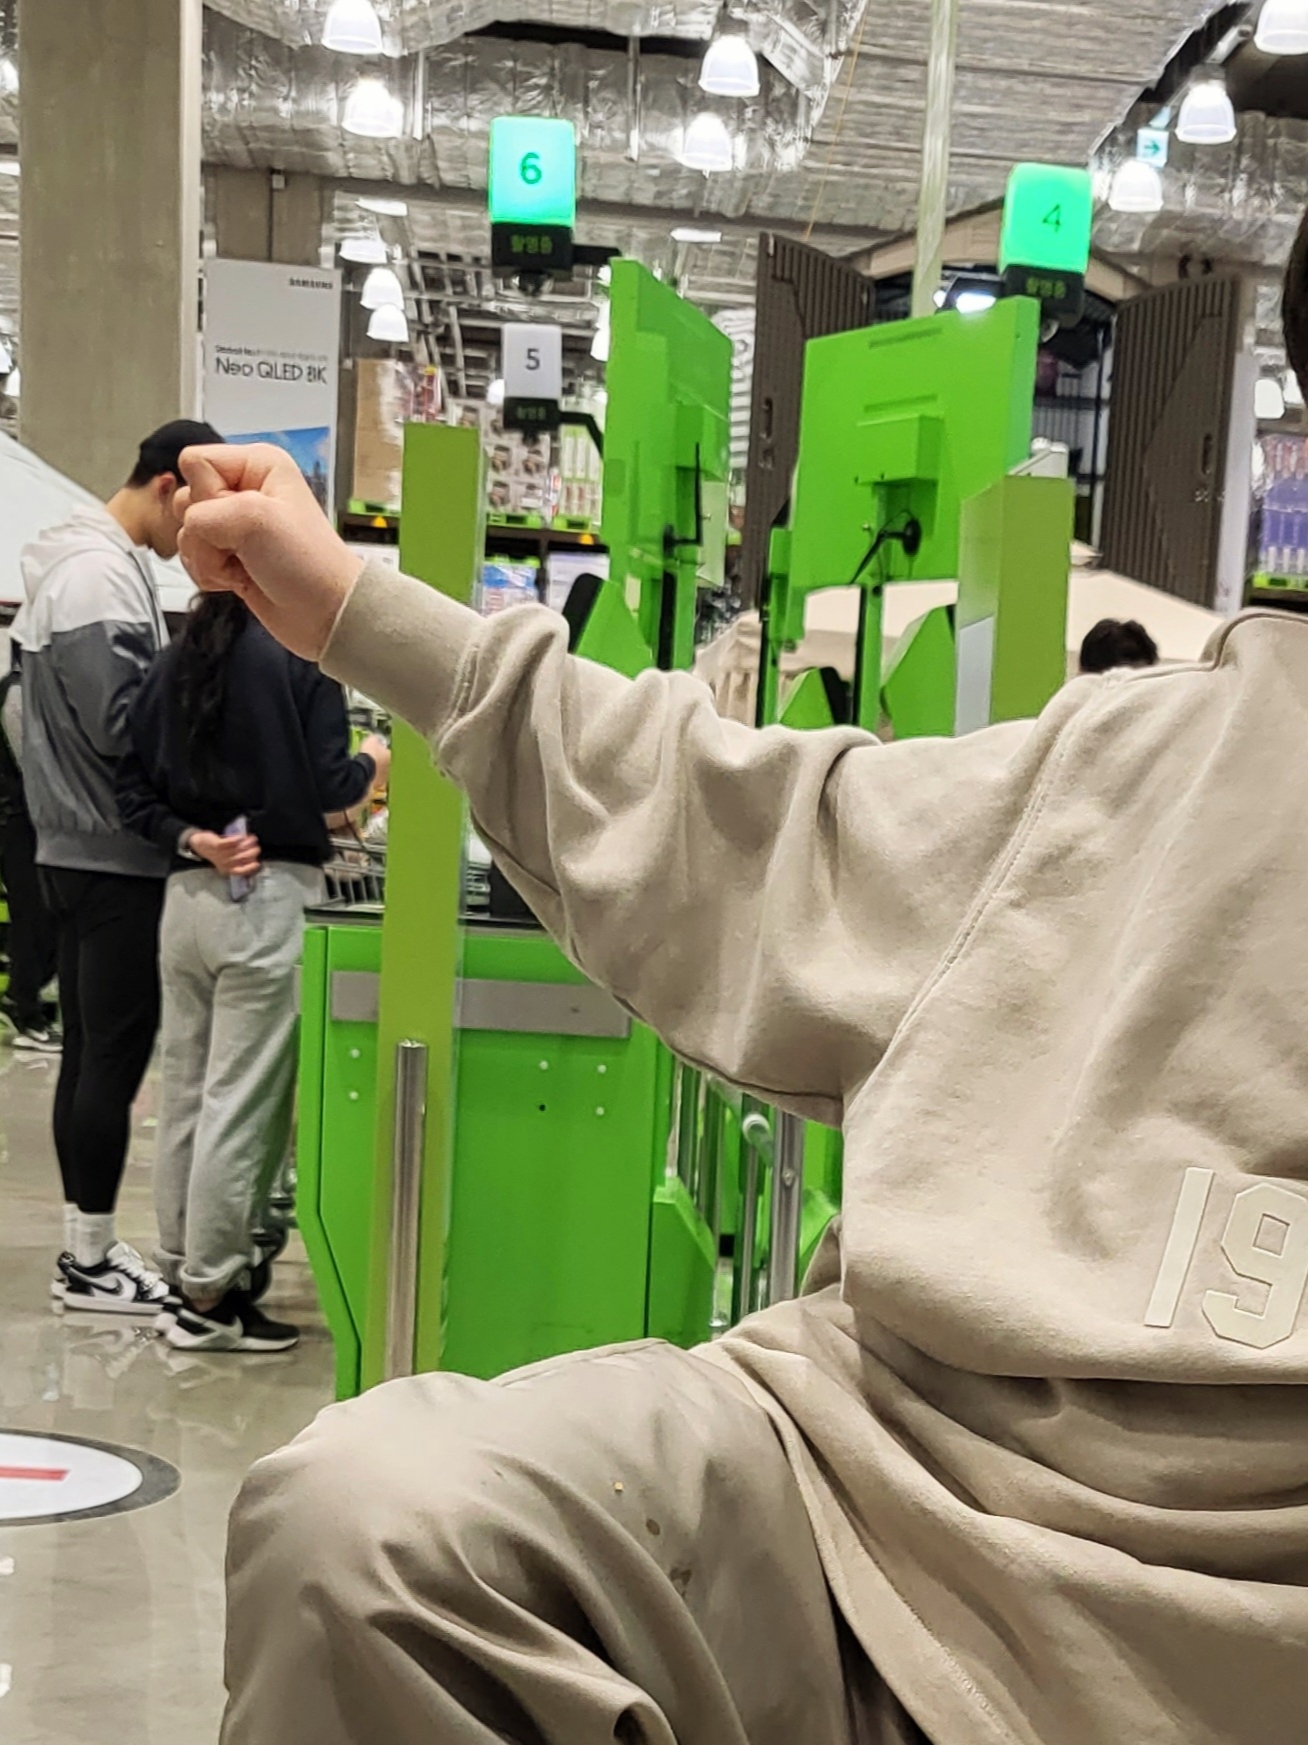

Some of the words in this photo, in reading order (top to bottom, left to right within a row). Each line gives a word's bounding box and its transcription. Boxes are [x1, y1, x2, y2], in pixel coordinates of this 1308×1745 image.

[520, 151, 543, 185] 6
[1042, 204, 1061, 233] 4
[215, 357, 254, 377] Neo
[257, 361, 304, 381] QLED
[525, 348, 540, 371] 5
